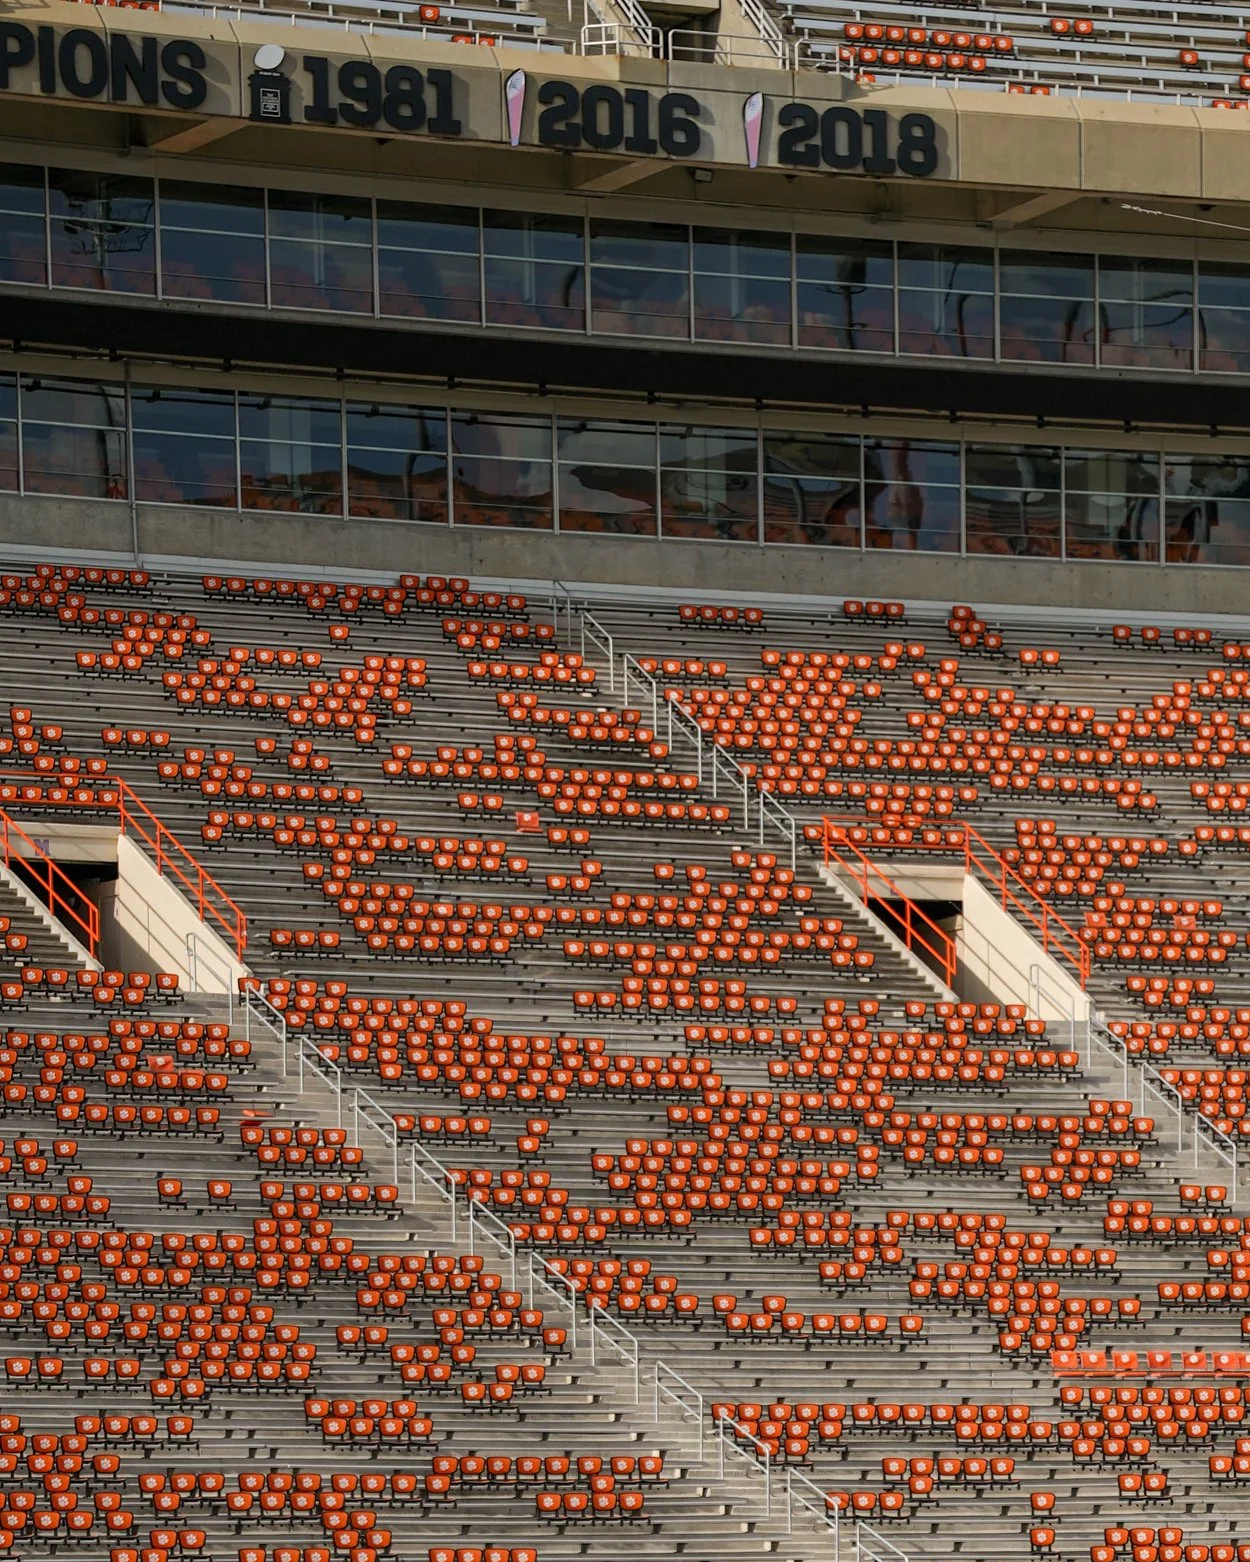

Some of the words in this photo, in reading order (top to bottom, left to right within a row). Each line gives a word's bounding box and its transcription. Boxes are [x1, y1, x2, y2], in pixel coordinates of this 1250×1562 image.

[303, 55, 462, 136] 1981
[538, 80, 701, 157] 2016
[778, 103, 938, 177] 2018
